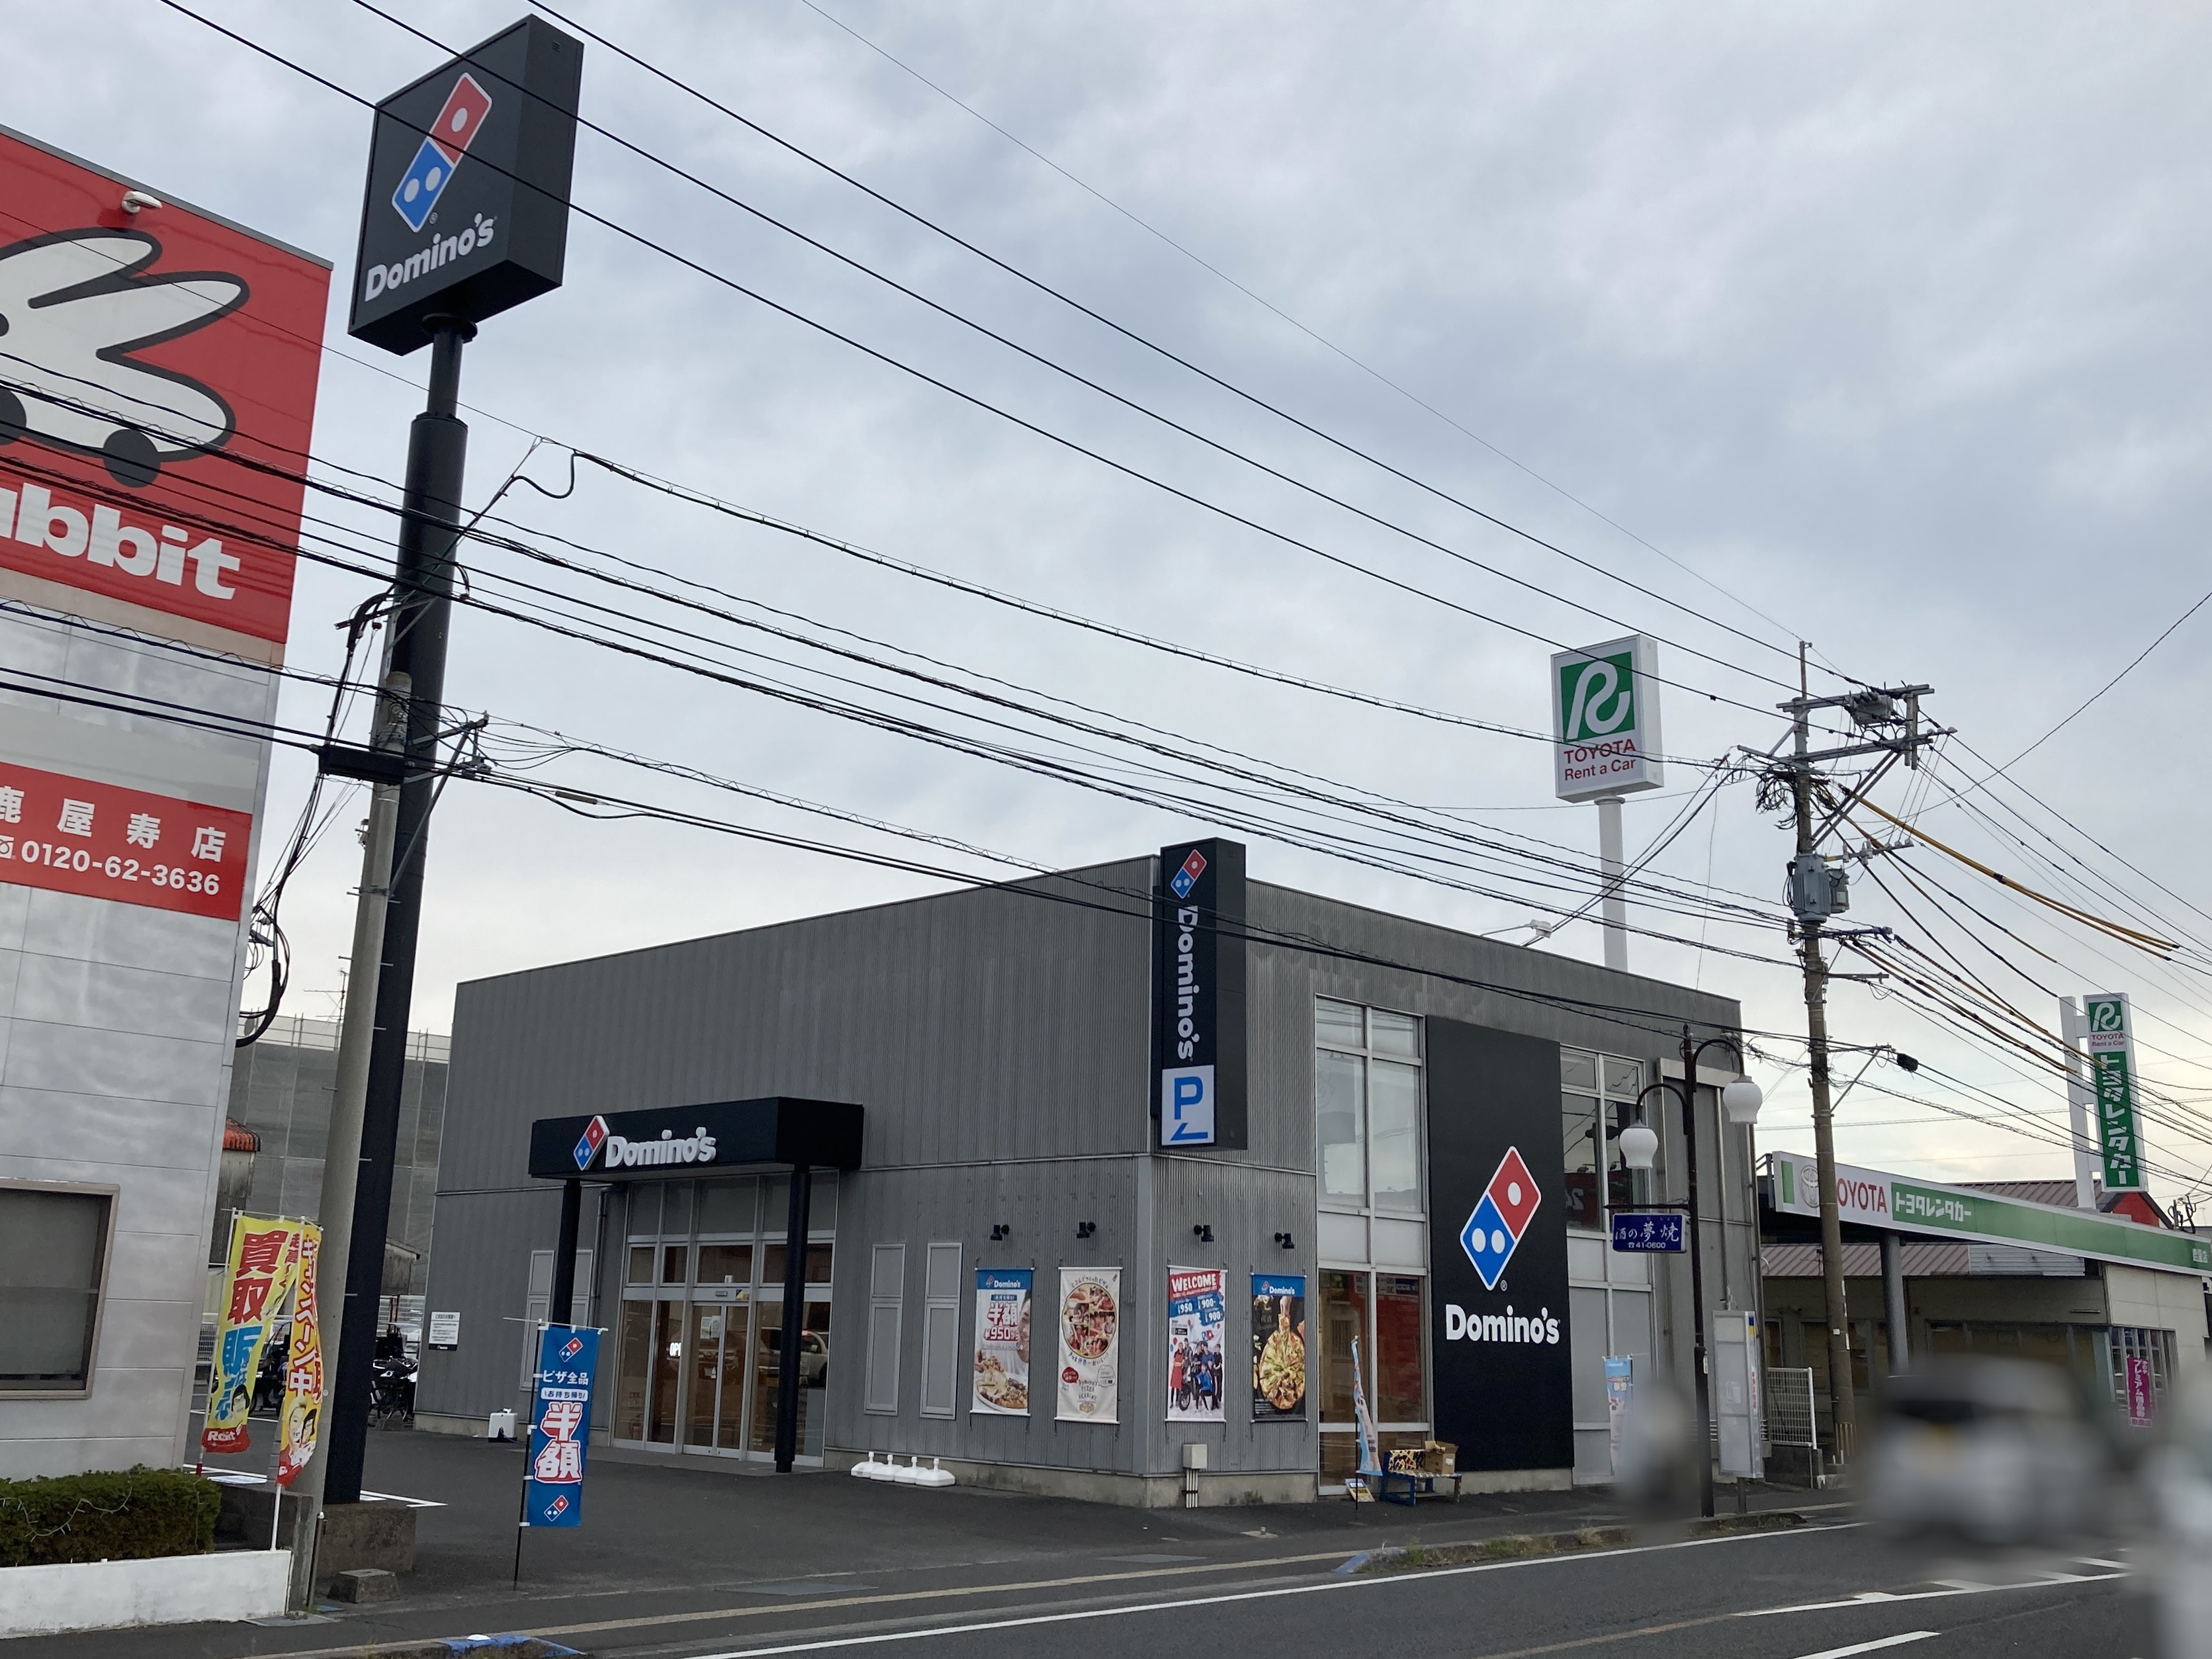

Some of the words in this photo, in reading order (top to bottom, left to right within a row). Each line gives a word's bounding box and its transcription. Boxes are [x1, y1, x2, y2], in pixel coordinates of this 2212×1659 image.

[364, 213, 495, 302] Domino's
[1564, 739, 1636, 764] TOYOTA
[1564, 766, 1595, 781] Rent
[1599, 765, 1607, 774] a
[1611, 758, 1636, 772] Car
[21, 840, 220, 895] 0120-62-3636
[1177, 905, 1200, 1060] Domino's
[1174, 1076, 1204, 1120] P
[2101, 1054, 2132, 1185] トヨタレンタカー
[605, 1126, 717, 1167] Domino's
[1836, 1178, 1887, 1213] OYOTA
[1896, 1192, 1972, 1222] トヨタレンタカー
[994, 1279, 1021, 1288] Domino's
[1171, 1273, 1217, 1292] WELCOME
[1269, 1286, 1295, 1295] Domino's
[987, 1302, 1019, 1326] 半額
[1445, 1304, 1560, 1345] Domino's
[543, 1370, 589, 1386] ピザ全品
[537, 1402, 582, 1481] 半額
